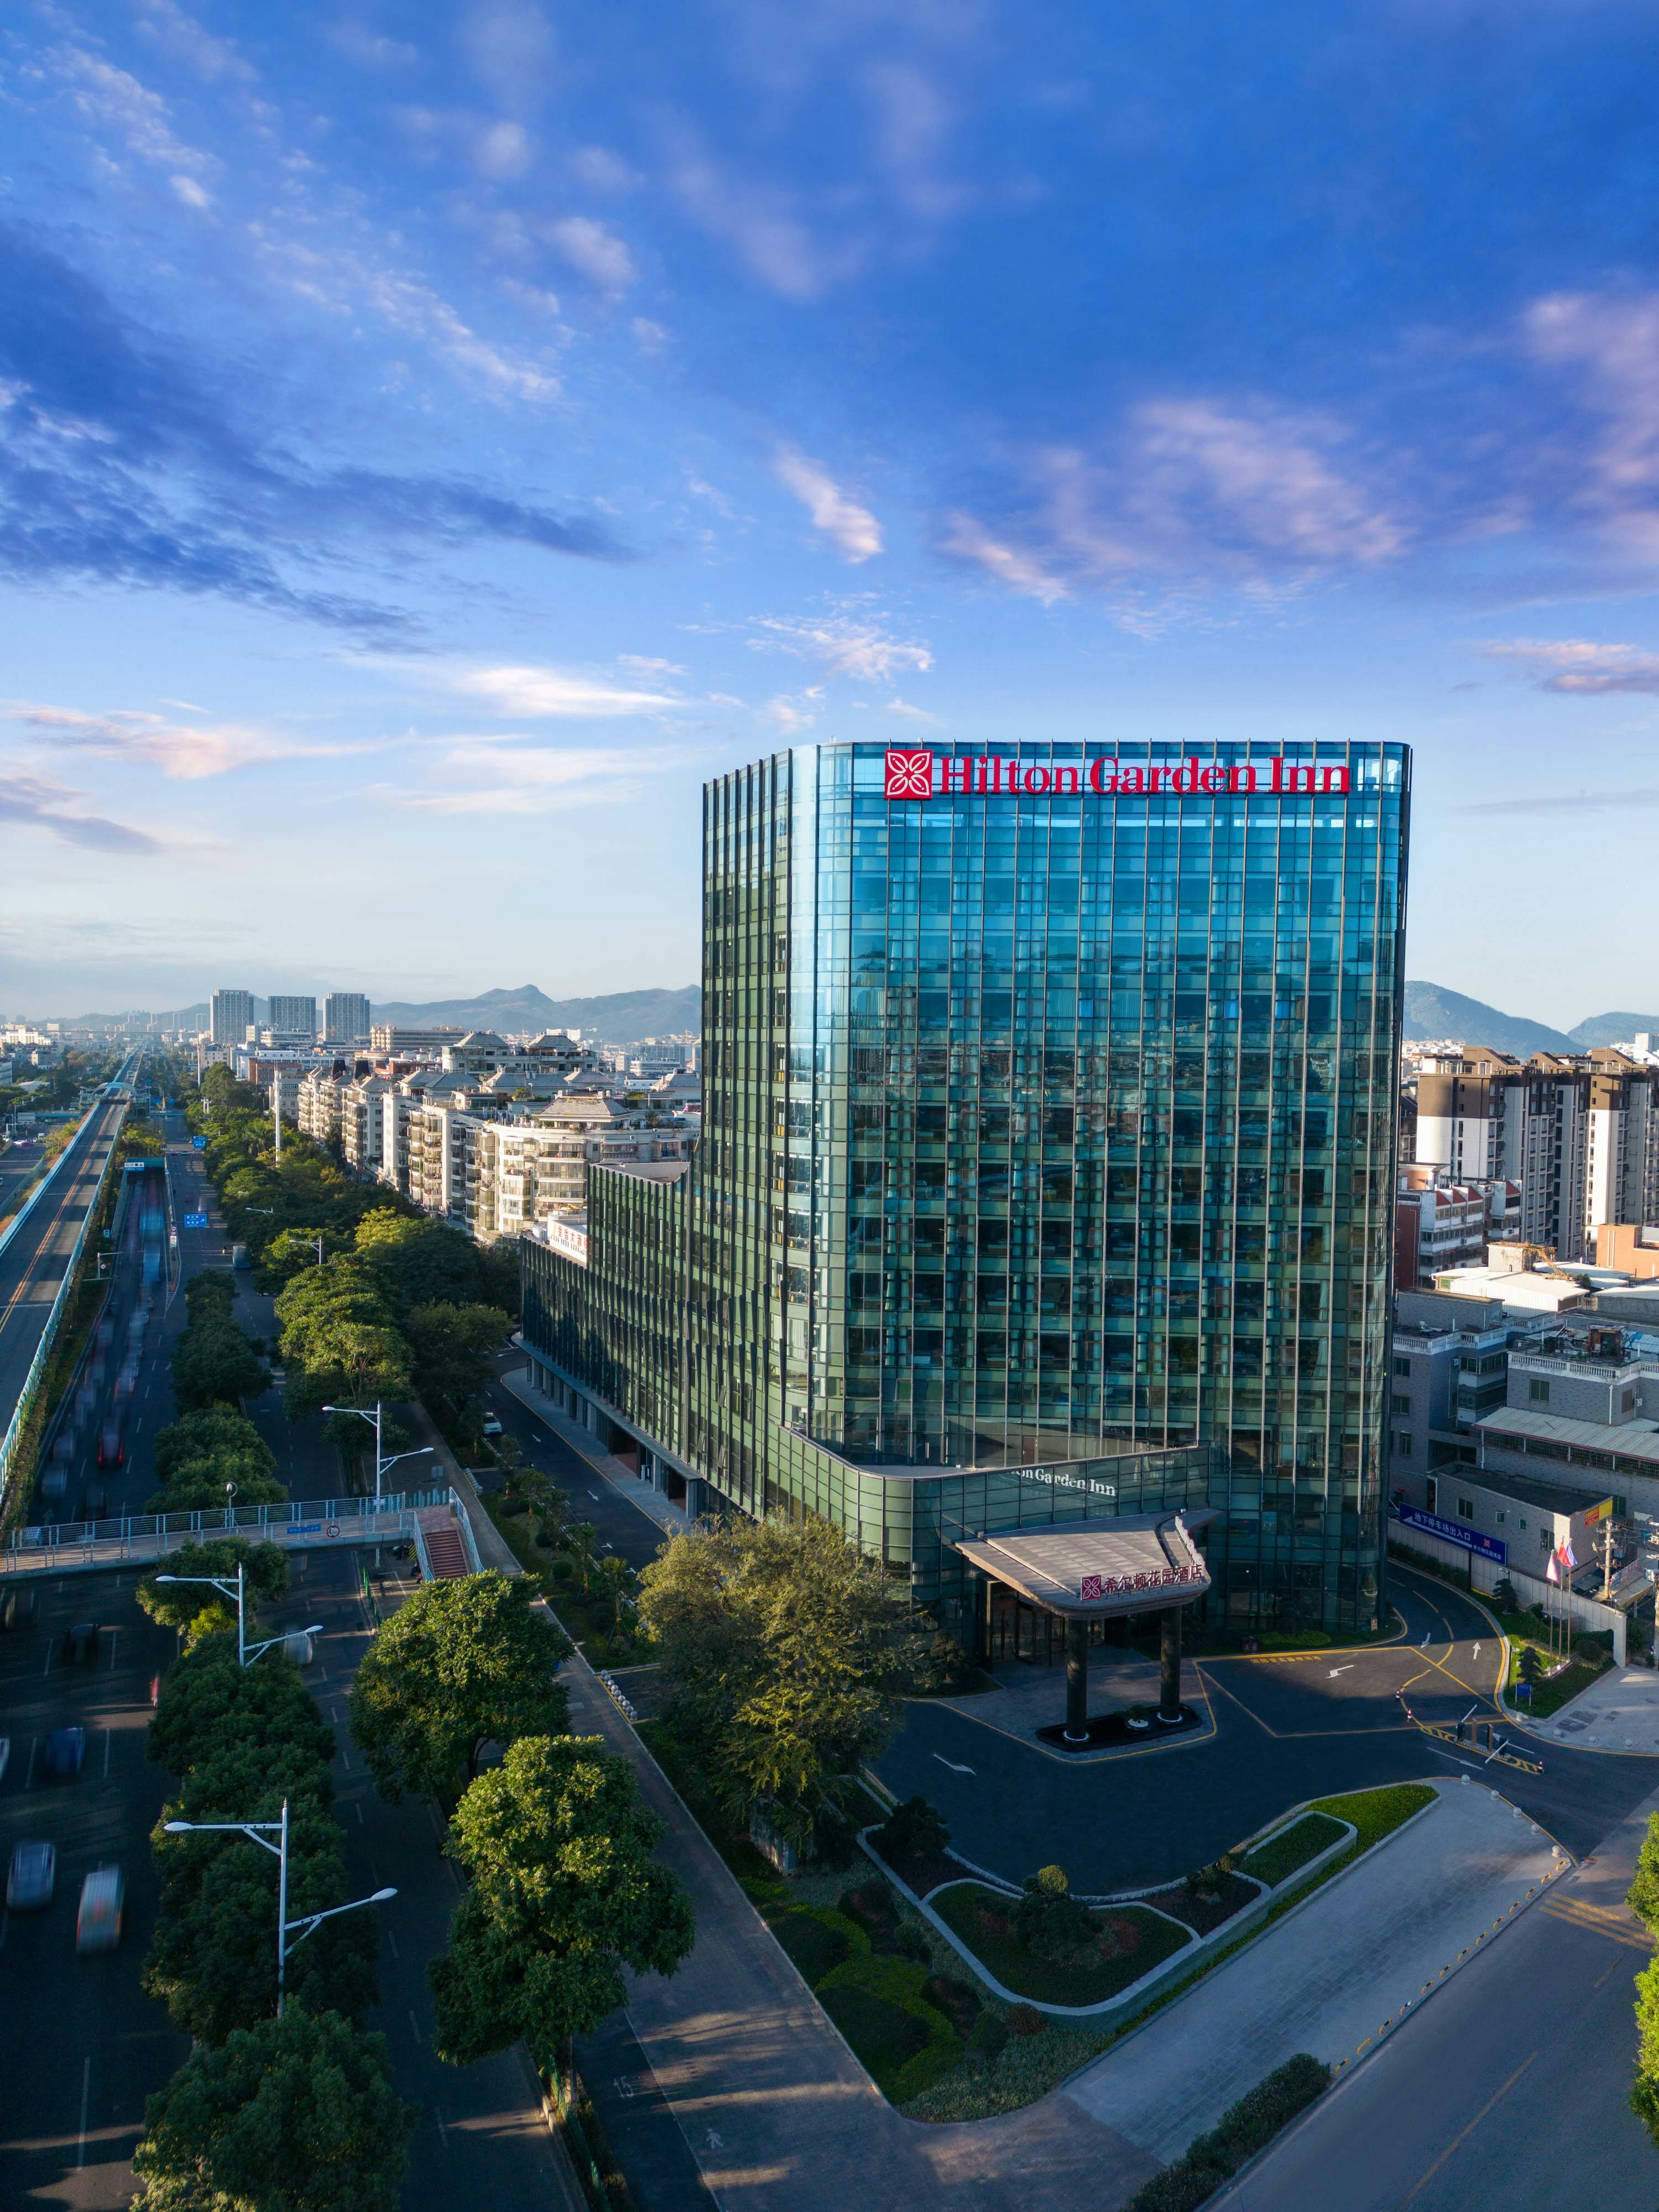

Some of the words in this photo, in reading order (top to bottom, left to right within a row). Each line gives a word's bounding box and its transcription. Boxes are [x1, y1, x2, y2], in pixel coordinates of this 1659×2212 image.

[939, 755, 1080, 794] Hilton
[1089, 756, 1260, 794] Garden
[1267, 756, 1353, 793] Inn
[1035, 1469, 1086, 1490] Garden
[1090, 1479, 1116, 1496] Inn
[1414, 1512, 1470, 1541] 地下停车场出入口
[1104, 1564, 1203, 1594] 希尔顿花园酒店
[614, 2077, 634, 2099] 15
